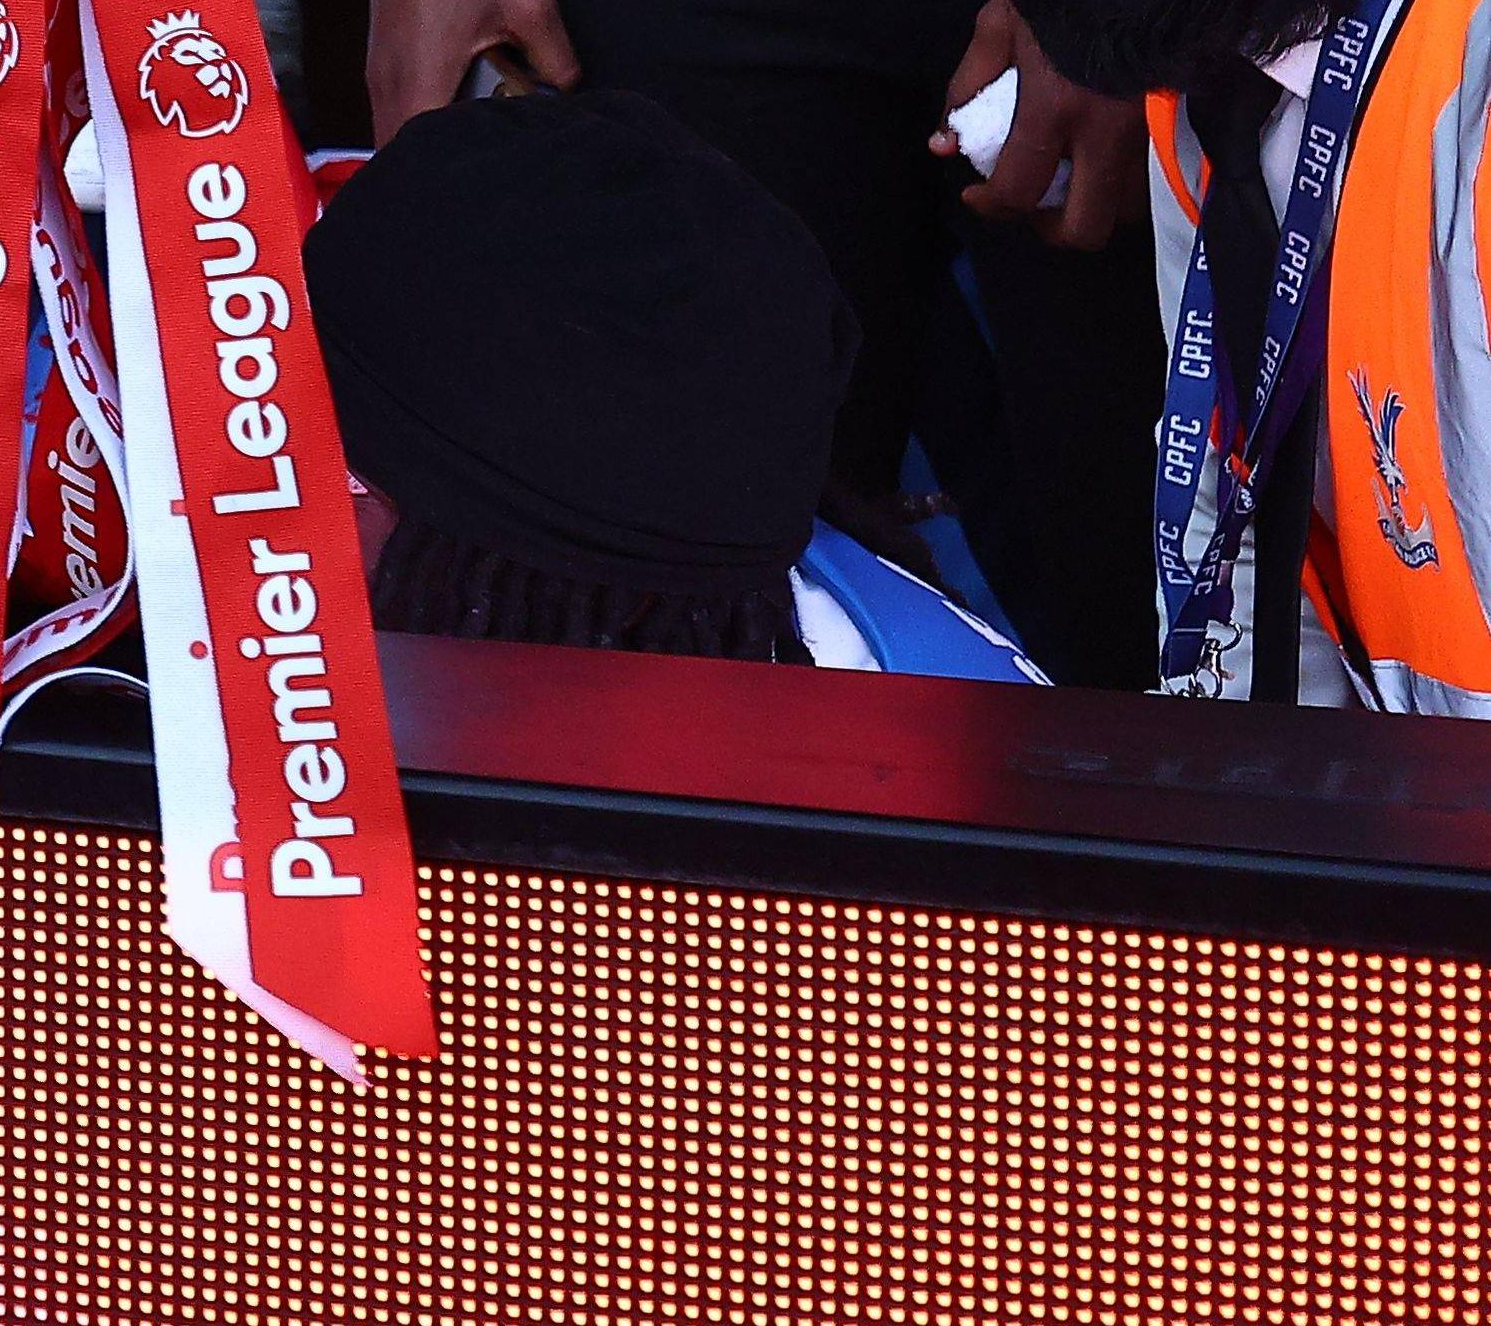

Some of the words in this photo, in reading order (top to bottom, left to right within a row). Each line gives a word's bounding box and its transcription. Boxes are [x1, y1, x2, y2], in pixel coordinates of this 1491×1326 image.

[1323, 14, 1369, 92] CPFC
[1298, 123, 1337, 199] CPFC
[1276, 230, 1311, 305] CPFC
[187, 159, 304, 517] League
[1178, 307, 1213, 380] CPFC
[1255, 334, 1281, 406] CPFC
[1164, 414, 1201, 487] CPFC
[46, 415, 104, 599] emie
[1159, 519, 1193, 586] CPFC
[239, 533, 364, 899] Premier
